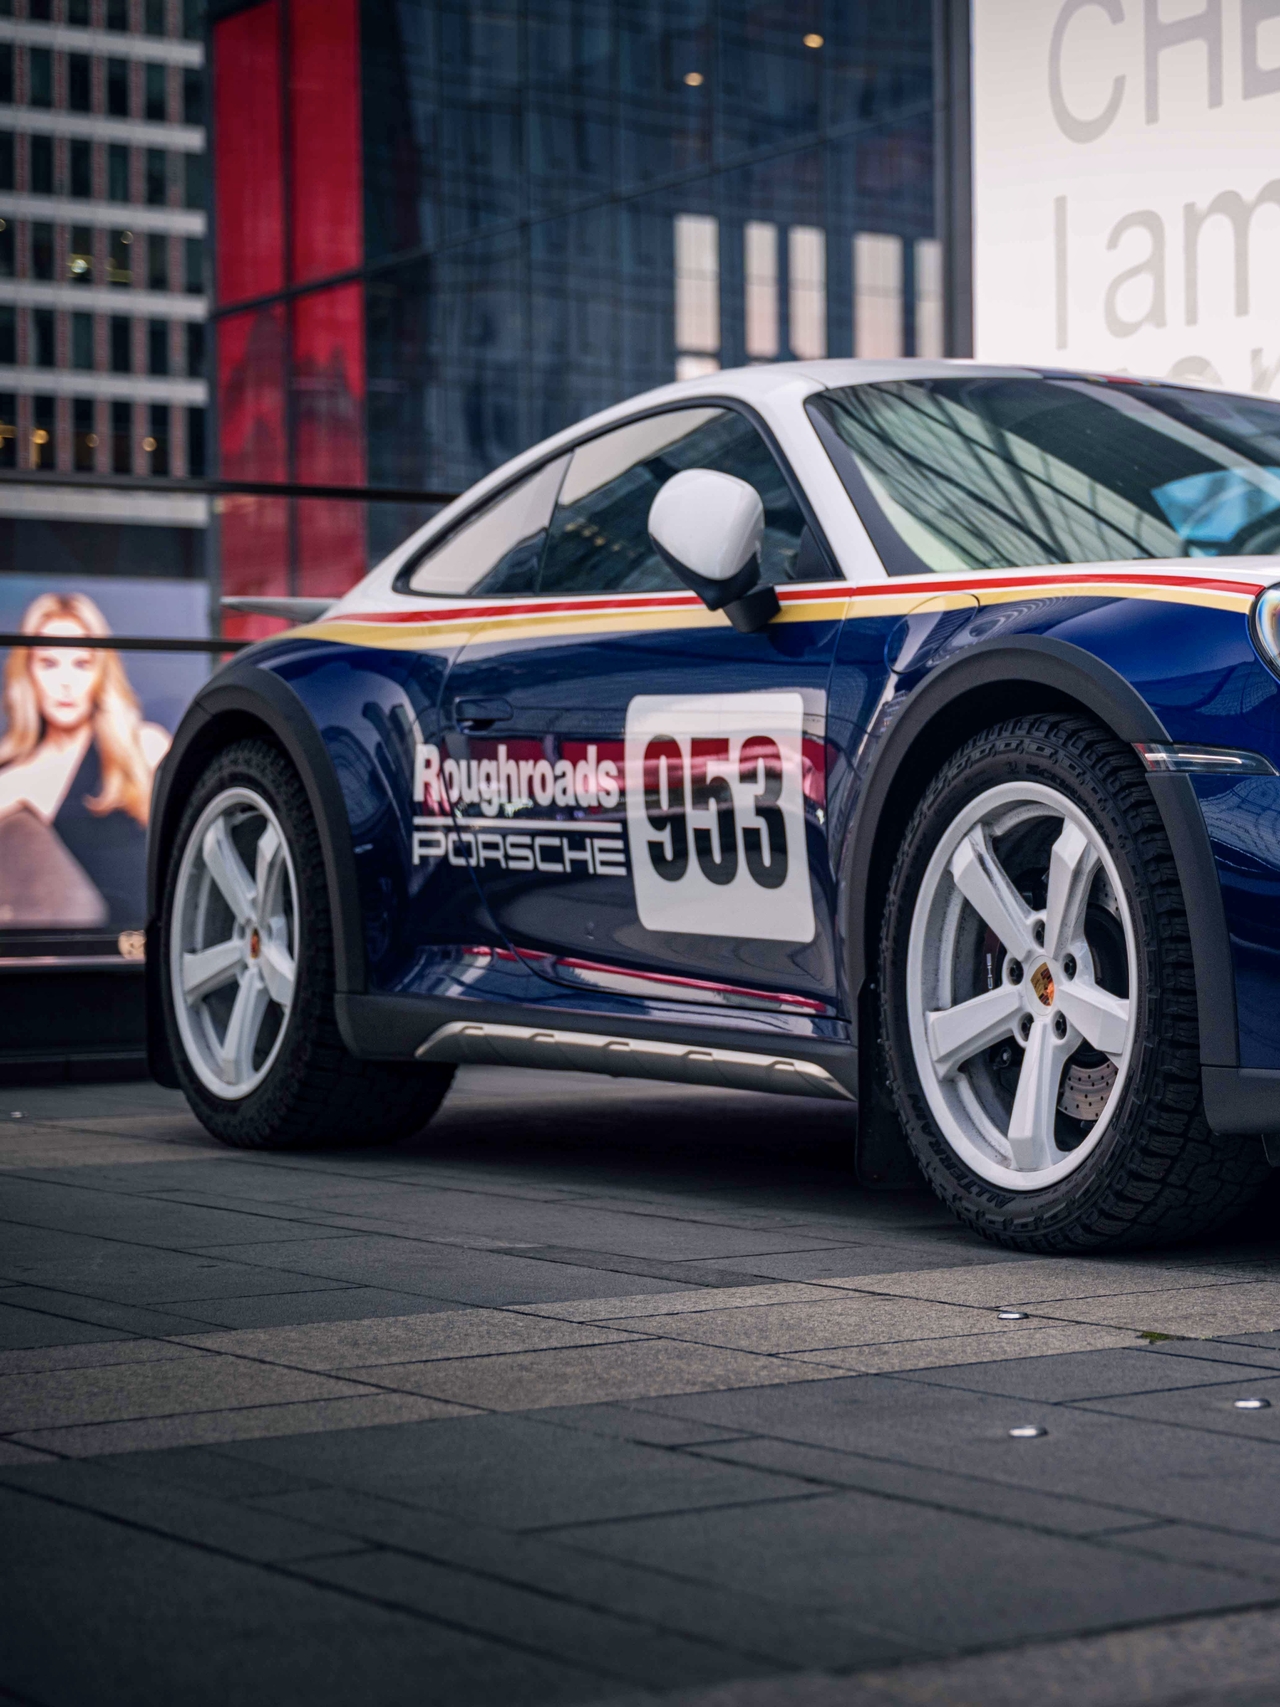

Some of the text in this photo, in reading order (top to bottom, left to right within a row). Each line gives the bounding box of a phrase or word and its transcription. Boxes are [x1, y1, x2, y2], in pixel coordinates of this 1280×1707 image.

[413, 743, 620, 817] Roughroads
[643, 734, 789, 890] 953
[412, 831, 628, 876] PORSCHE
